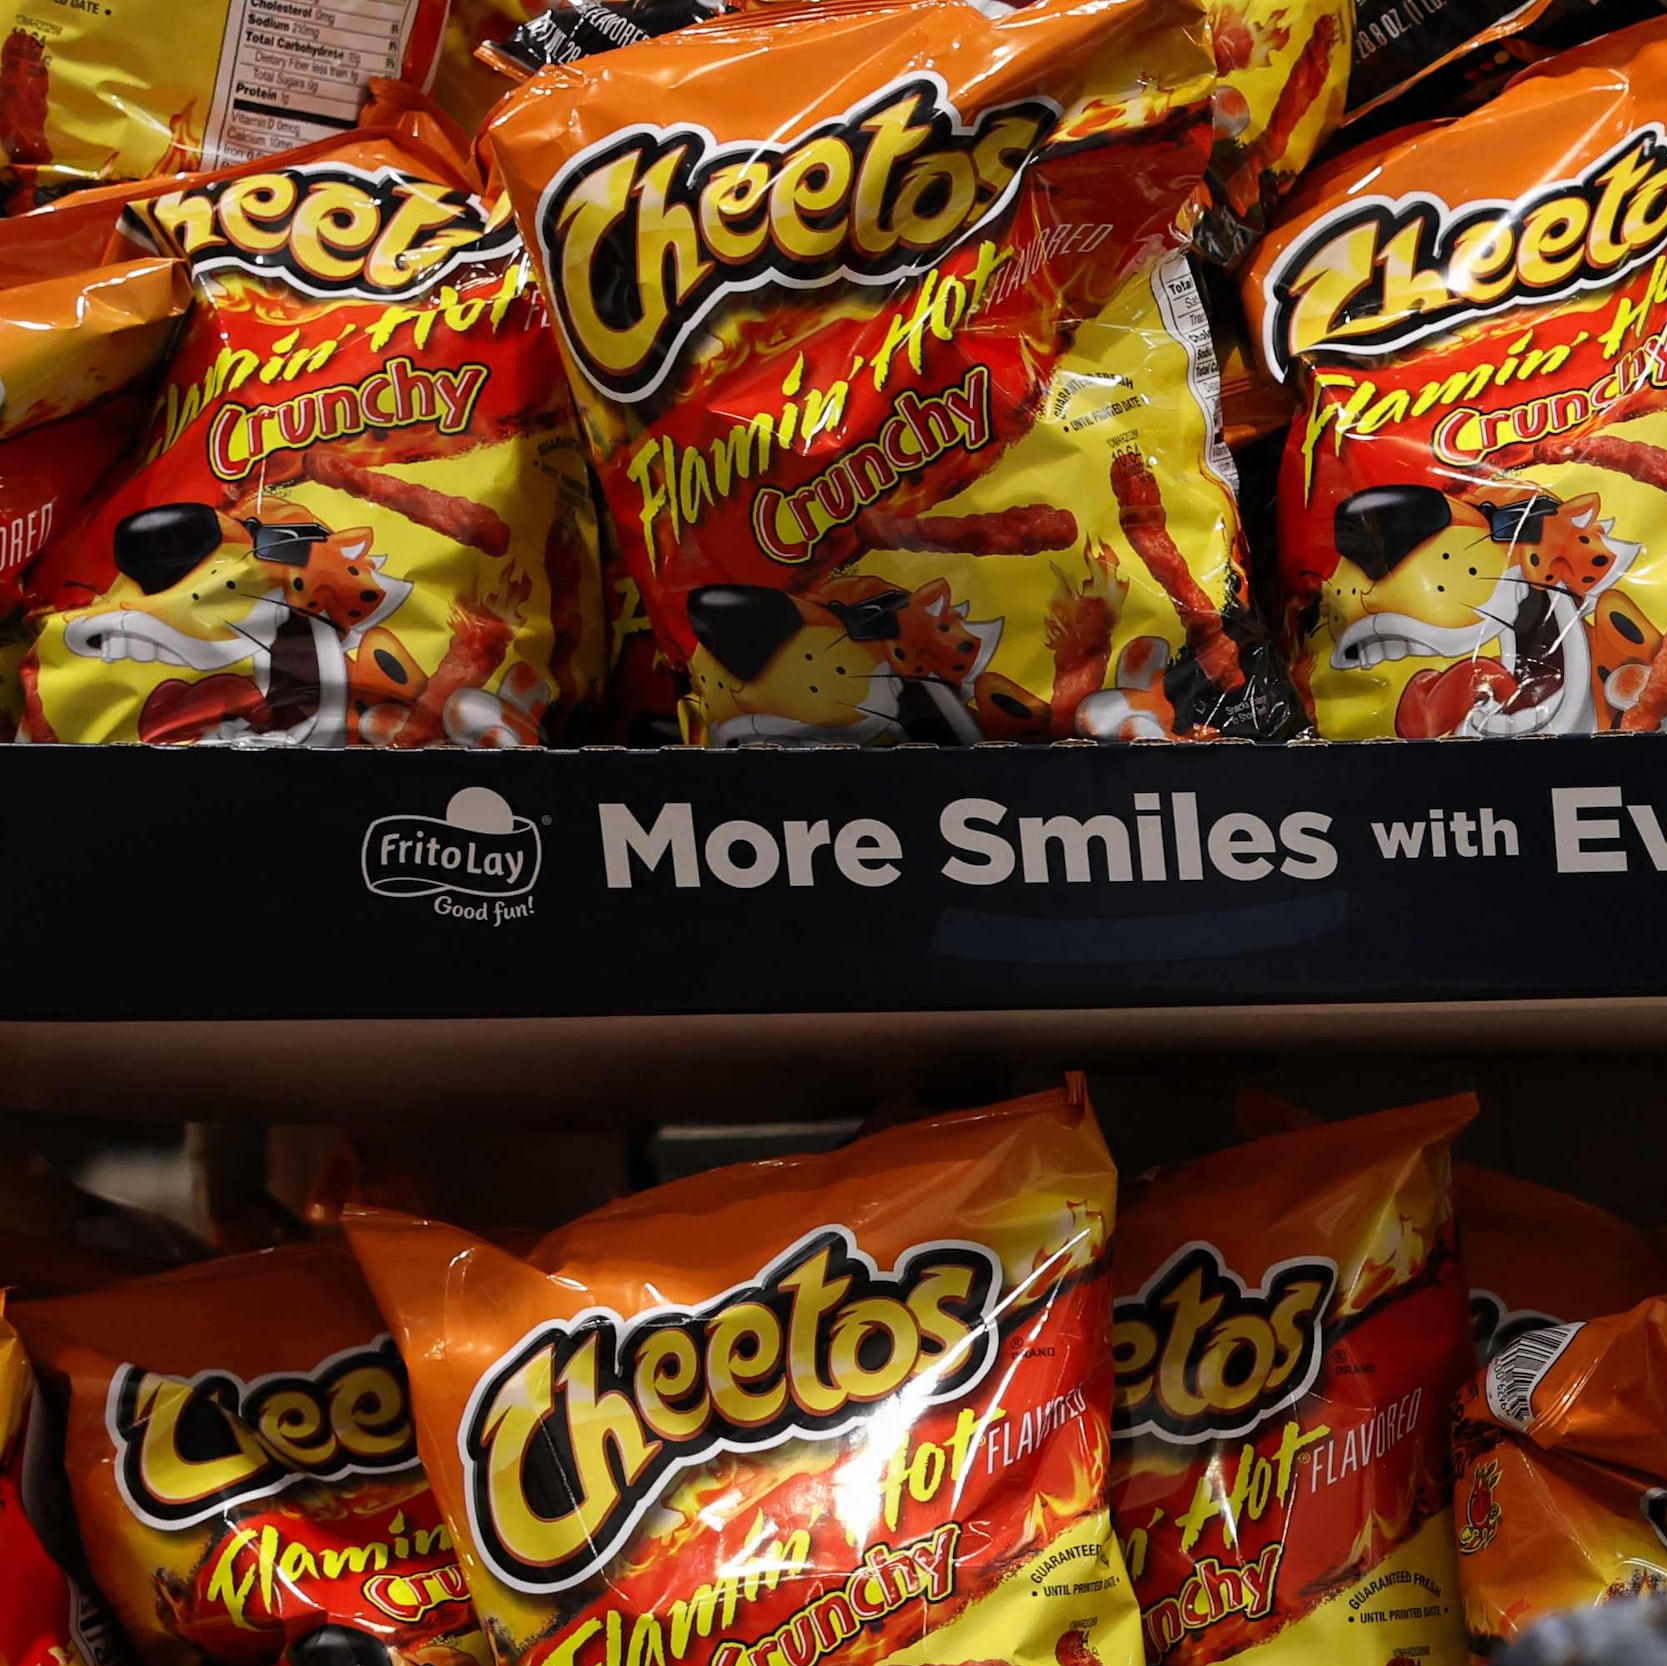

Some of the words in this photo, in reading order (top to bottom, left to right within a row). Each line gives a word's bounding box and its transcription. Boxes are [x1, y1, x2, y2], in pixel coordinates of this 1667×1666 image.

[248, 14, 290, 32] Sodium
[245, 31, 274, 46] Total
[277, 37, 344, 60] Carbohydrate
[254, 51, 286, 69] Dietary
[236, 82, 277, 100] Protein
[253, 68, 274, 82] Total
[276, 73, 305, 90] Sugars
[231, 110, 266, 128] Vitamin
[545, 88, 1060, 385] Cheetos
[627, 350, 866, 578] Flamin'
[872, 240, 1016, 391] Hot
[988, 223, 1114, 313] FLAVORED
[1122, 395, 1141, 413] DATE
[209, 357, 492, 481] Crunchy
[1300, 330, 1582, 507] Flamin'
[750, 366, 994, 563] Crunchy
[599, 802, 903, 889] More
[939, 792, 1339, 886] Smiles
[1371, 806, 1520, 861] with
[433, 895, 490, 922] Good
[492, 897, 535, 928] fun!
[476, 1235, 990, 1580] Cheetos
[1174, 1420, 1332, 1553] Hot
[1311, 1387, 1424, 1494] FLAVORED
[1043, 1584, 1071, 1598] UNTIL
[1073, 1579, 1102, 1596] PRINTED
[1349, 1570, 1412, 1611] GUARANTEED
[1413, 1572, 1443, 1599] FRESH
[1360, 1611, 1388, 1624] UNTIL
[1389, 1606, 1422, 1623] PRINTED
[1423, 1605, 1442, 1619] DATE
